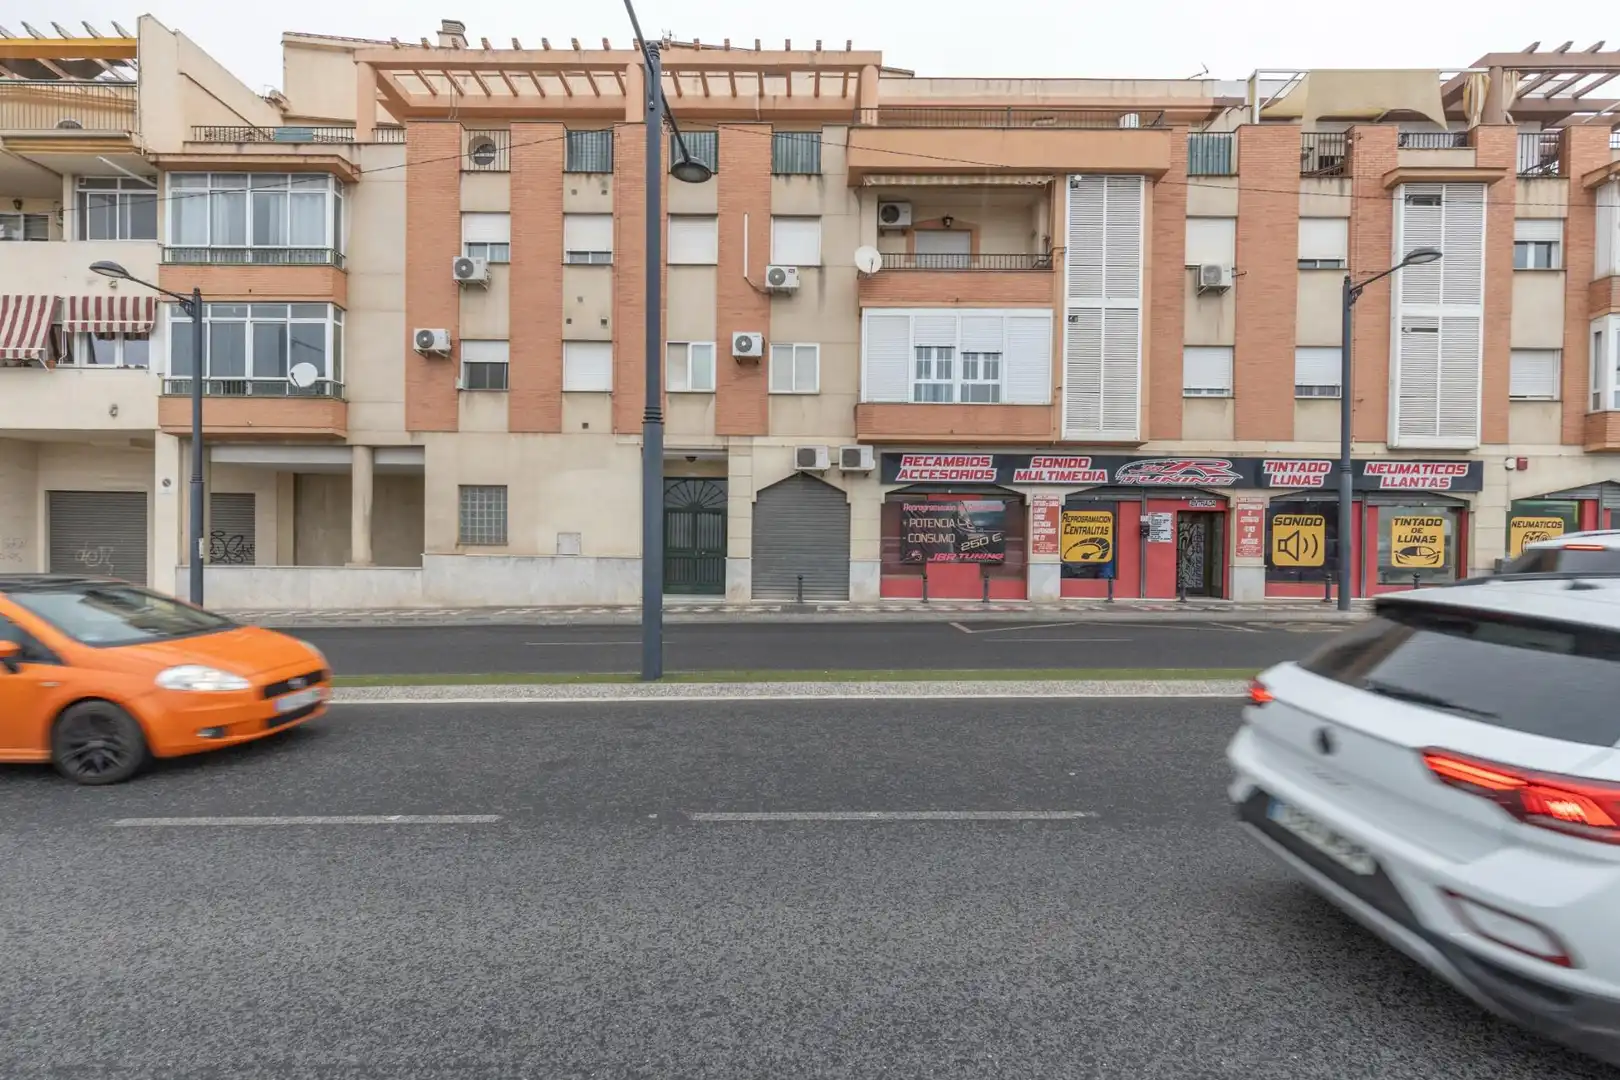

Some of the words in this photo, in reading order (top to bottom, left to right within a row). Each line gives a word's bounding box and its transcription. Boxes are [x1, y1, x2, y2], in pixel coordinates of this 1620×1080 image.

[902, 456, 991, 467] RECAMBIOS
[1031, 457, 1089, 468] SONIDO
[1265, 461, 1330, 473] TINTADO
[898, 469, 995, 480] ACCESORIOS
[1366, 463, 1466, 475] NEUMATICOS
[1015, 470, 1106, 481] MULTIMEDIA
[1272, 474, 1323, 485] LUNAS
[1382, 476, 1450, 488] LLANTAS
[909, 518, 955, 528] POTENCIA
[1274, 517, 1323, 526] SONIDO
[1394, 518, 1443, 526] TINTADO
[908, 533, 956, 543] CONSUMO
[961, 536, 989, 551] 250
[1397, 535, 1437, 543] LUNAS
